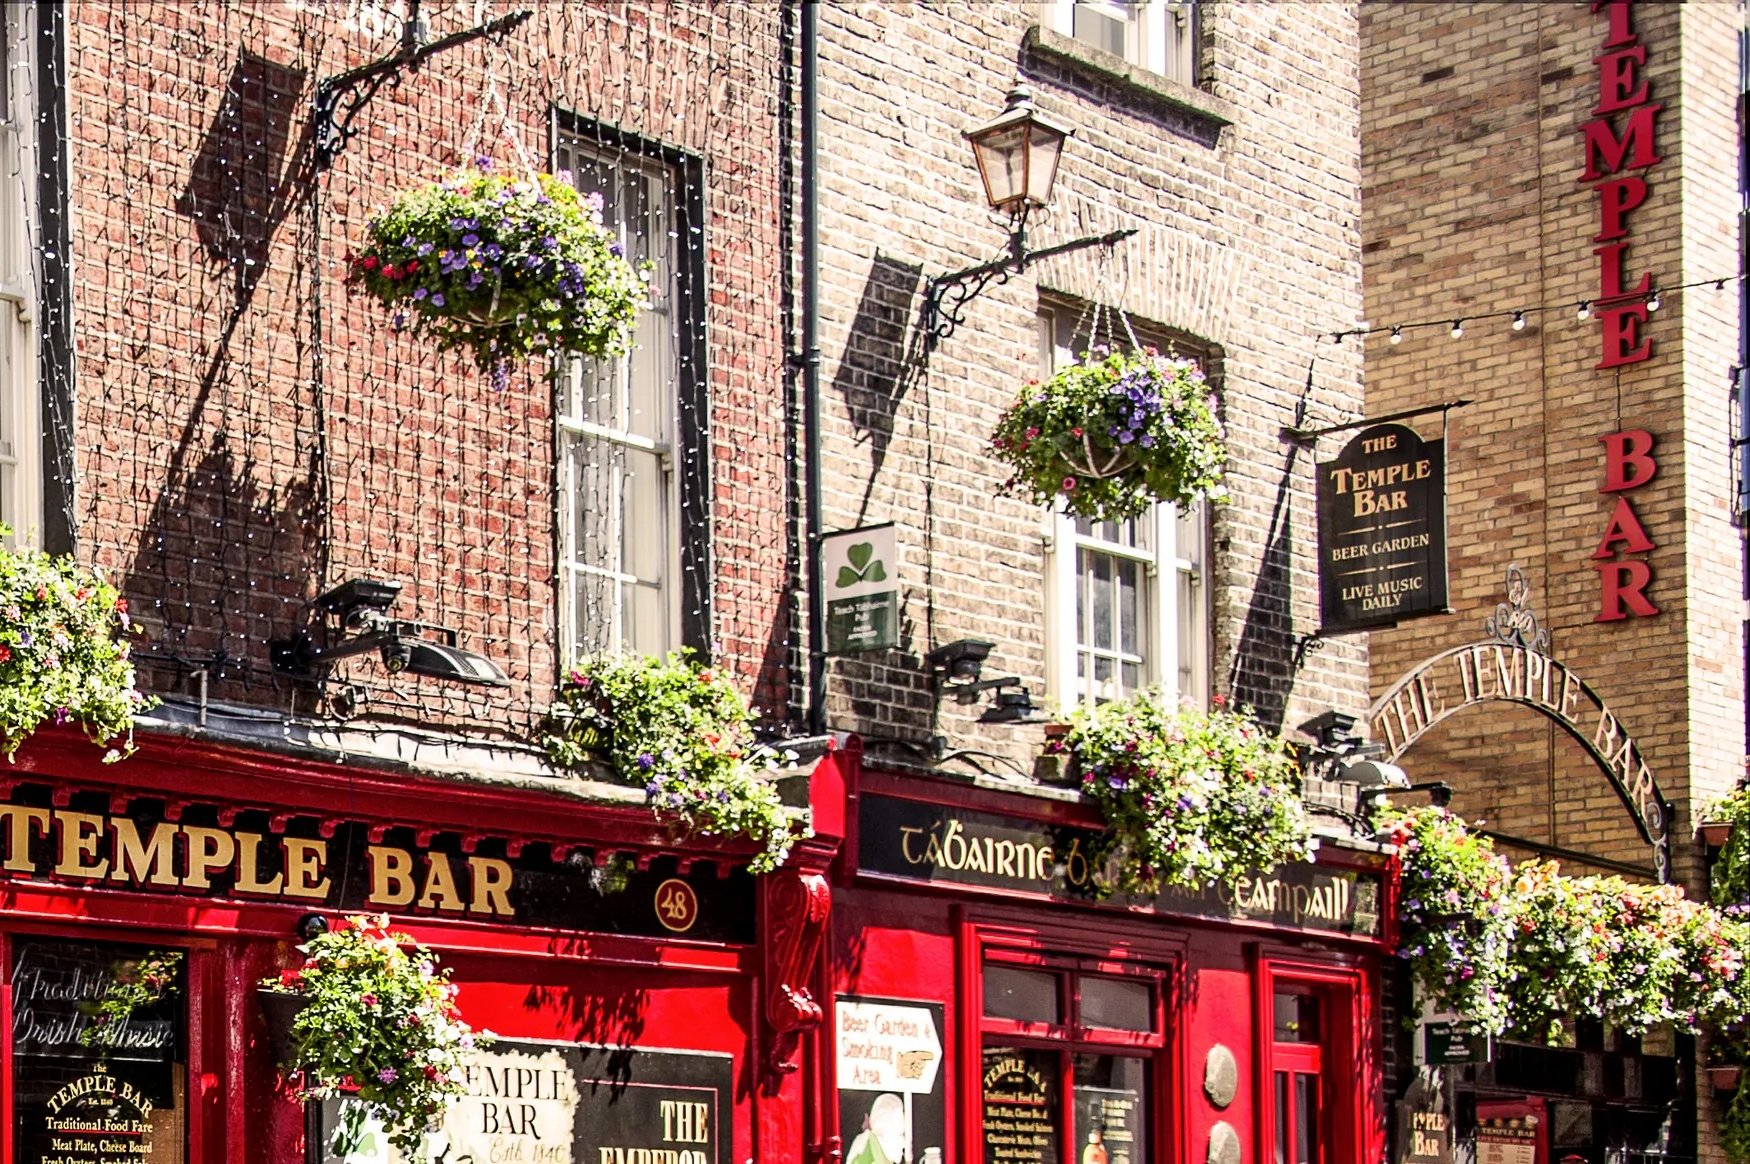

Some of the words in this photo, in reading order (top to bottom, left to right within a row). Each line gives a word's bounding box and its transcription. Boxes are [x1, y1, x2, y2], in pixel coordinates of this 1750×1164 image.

[1577, 0, 1661, 371] TEMPLE
[1362, 435, 1397, 454] THE
[1330, 459, 1431, 495] TEMPLE
[1353, 490, 1408, 518] BAR
[1592, 429, 1659, 624] BAR
[1332, 544, 1369, 561] BEER
[1372, 533, 1430, 555] GARDEN
[1342, 583, 1373, 600] LIVE
[1378, 577, 1422, 596] MUSIC
[1362, 593, 1402, 611] DAILY
[1375, 667, 1445, 757] THE
[1454, 644, 1582, 724] TEMPLE
[1594, 706, 1652, 820] BAR
[368, 845, 516, 916] BAR
[661, 888, 688, 922] 48
[842, 1010, 869, 1032] Beer
[875, 1013, 918, 1037] Garden
[842, 1037, 893, 1064] Smoking
[93, 1063, 107, 1072] The
[853, 1064, 881, 1084] Area
[984, 1059, 1025, 1088] TEMPLE
[47, 1075, 117, 1114] TEMPLE
[119, 1082, 153, 1119] BAR
[466, 1065, 569, 1102] EMPLE
[46, 1117, 101, 1131] Traditional
[104, 1117, 128, 1132] Food
[132, 1120, 153, 1133] Fare
[481, 1102, 542, 1140] BAR
[660, 1100, 709, 1144] THE
[1405, 1105, 1445, 1131] TEPLE
[52, 1138, 72, 1151] Meat
[75, 1139, 98, 1154] Plate,
[100, 1140, 127, 1153] Cheese
[129, 1141, 153, 1153] Board
[1414, 1131, 1439, 1156] BAR
[1482, 1128, 1514, 1136] TEMPLE
[1518, 1129, 1536, 1137] BAR
